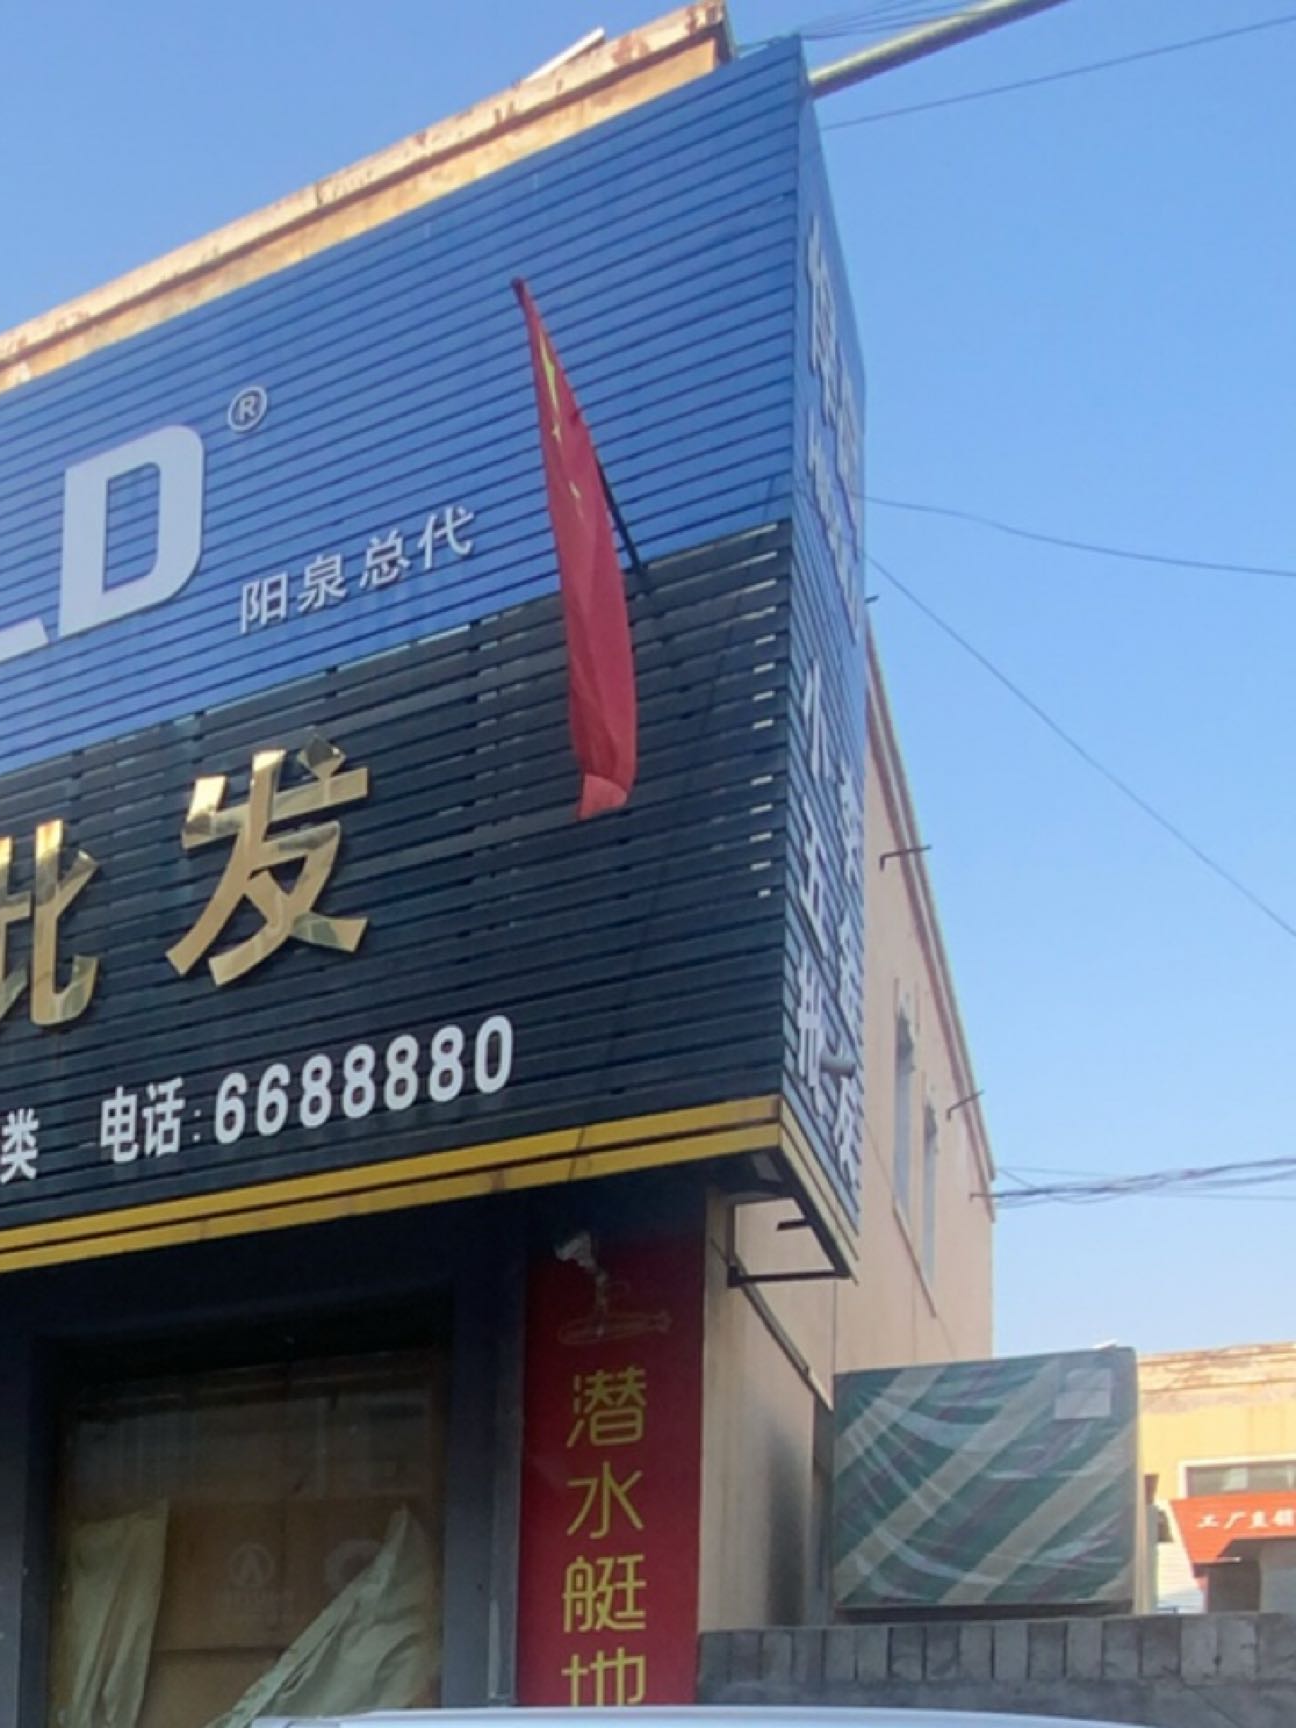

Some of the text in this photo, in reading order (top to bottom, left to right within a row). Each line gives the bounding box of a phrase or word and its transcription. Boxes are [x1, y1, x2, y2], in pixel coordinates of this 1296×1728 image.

[239, 503, 477, 636] 阳泉总代
[561, 1365, 648, 1708] 潜水艇地
